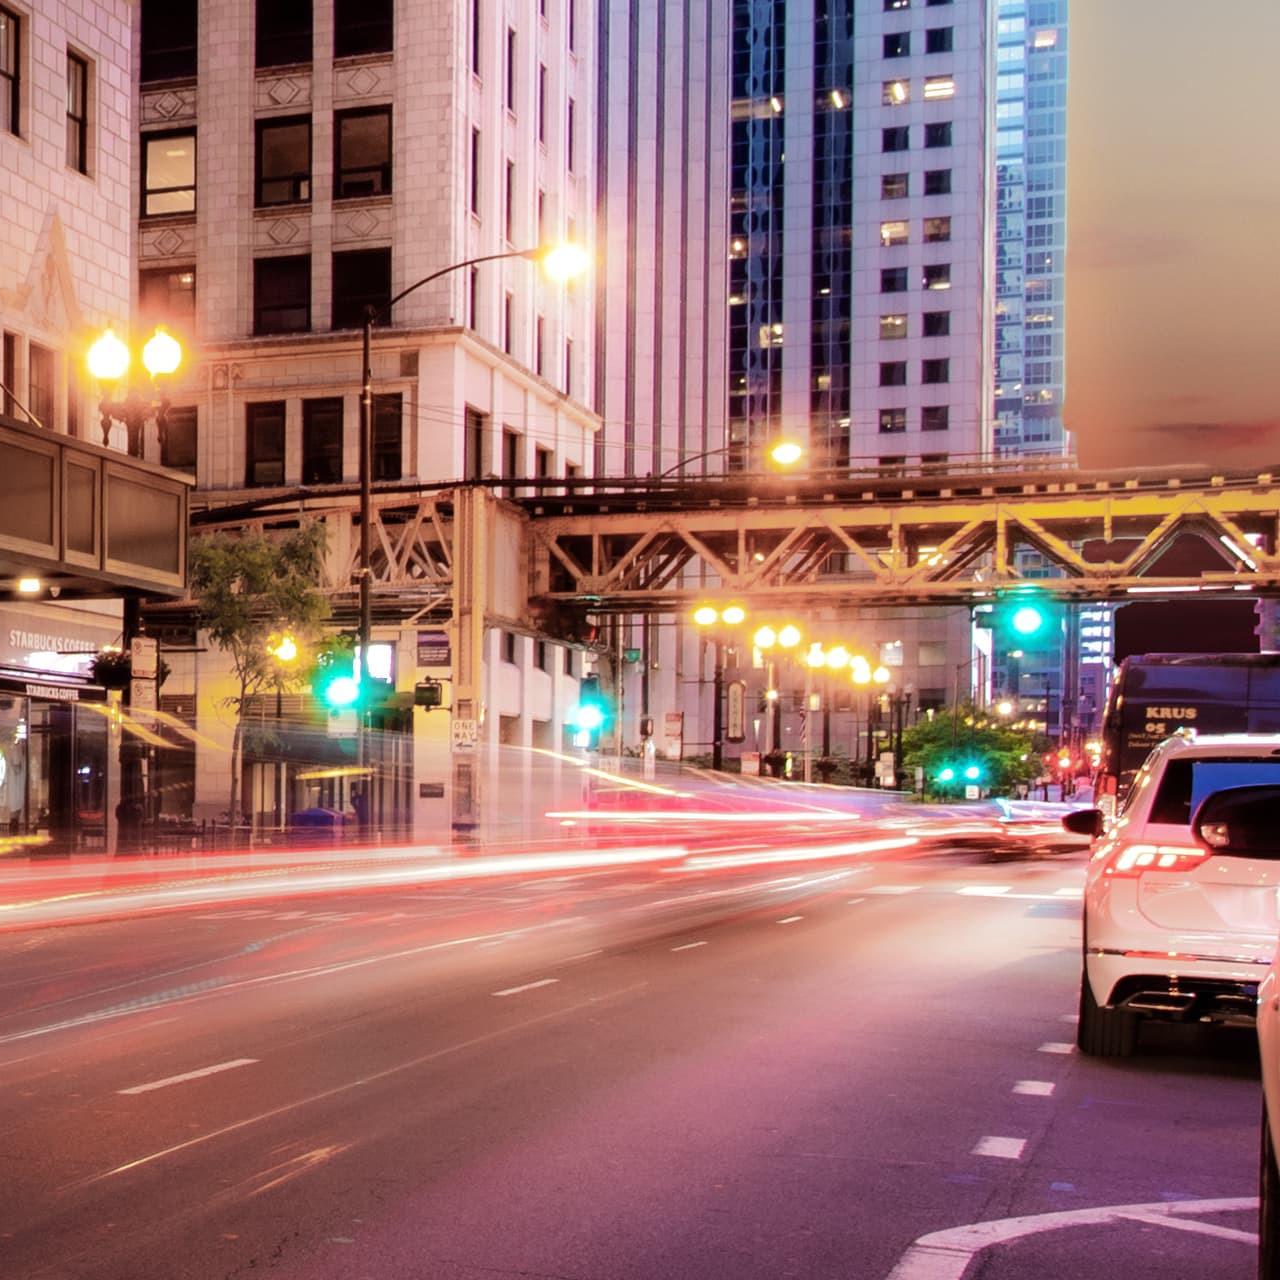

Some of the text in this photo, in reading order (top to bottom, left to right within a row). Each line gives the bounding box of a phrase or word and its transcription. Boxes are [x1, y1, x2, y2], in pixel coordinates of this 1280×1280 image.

[9, 629, 96, 652] STARBUCKS COFFEE
[25, 683, 80, 701] STARBUCKS COFFEE
[1146, 706, 1197, 719] KRUS
[454, 721, 474, 731] ONE
[454, 732, 475, 741] WAY
